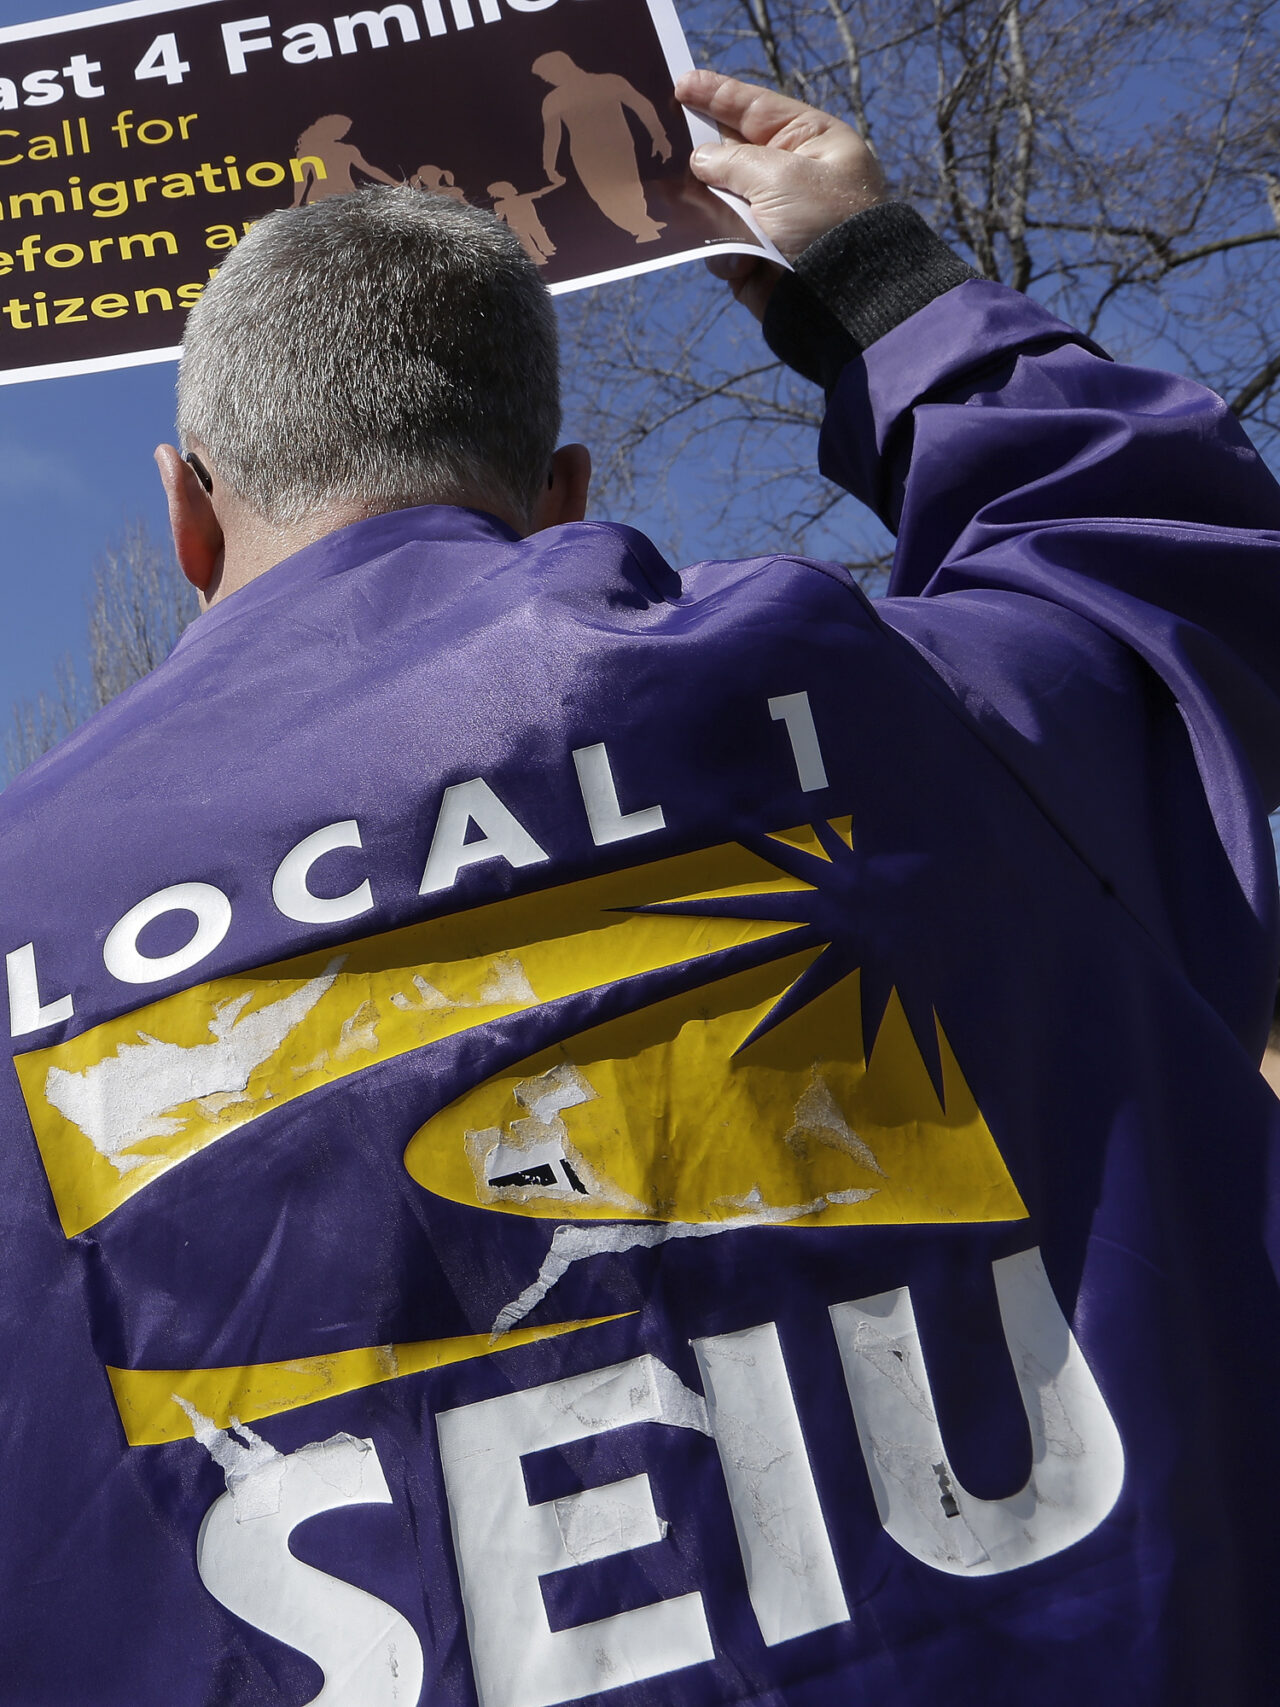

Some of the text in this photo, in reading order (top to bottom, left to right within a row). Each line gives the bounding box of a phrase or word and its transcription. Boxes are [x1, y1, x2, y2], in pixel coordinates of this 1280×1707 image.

[111, 110, 198, 149] for
[134, 32, 191, 86] 4
[6, 691, 830, 1037] LOCAL 1
[196, 1245, 1126, 1707] SEIU
